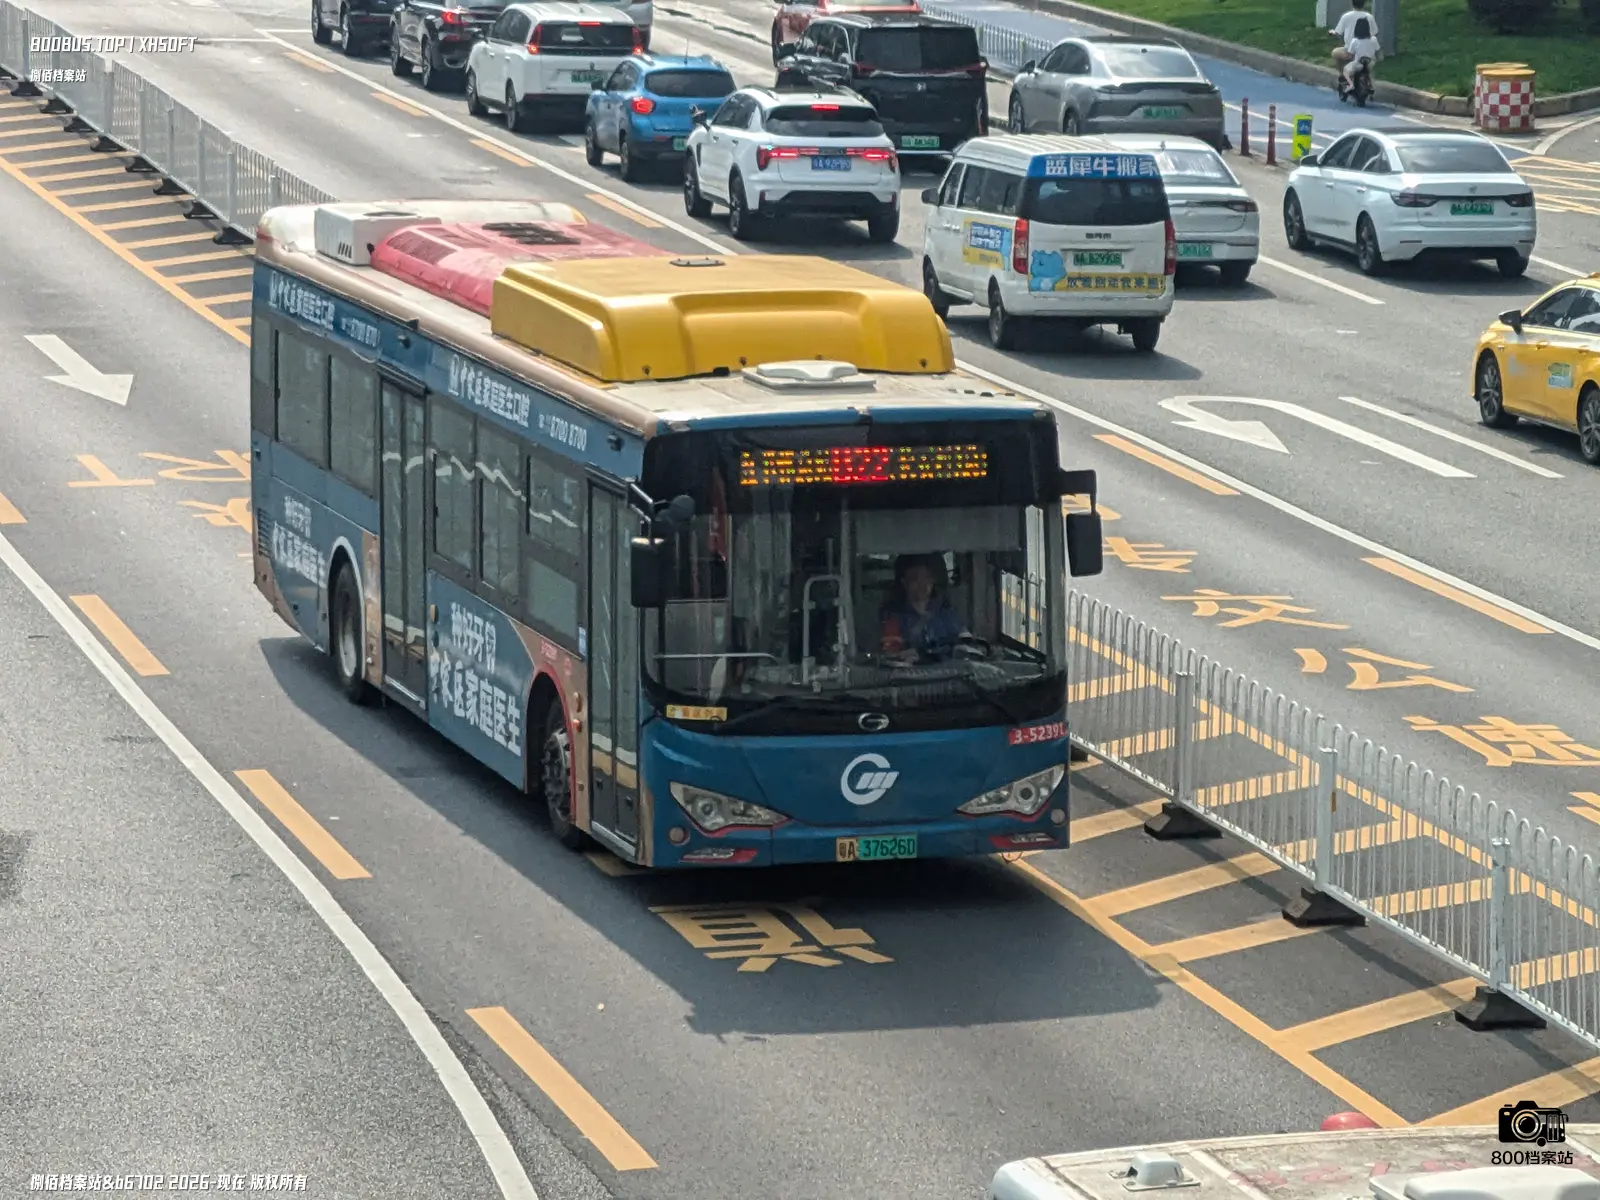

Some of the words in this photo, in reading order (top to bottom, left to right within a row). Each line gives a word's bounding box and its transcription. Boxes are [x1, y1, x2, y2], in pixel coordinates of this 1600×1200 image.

[1044, 155, 1158, 177] 蓝犀牛搬家
